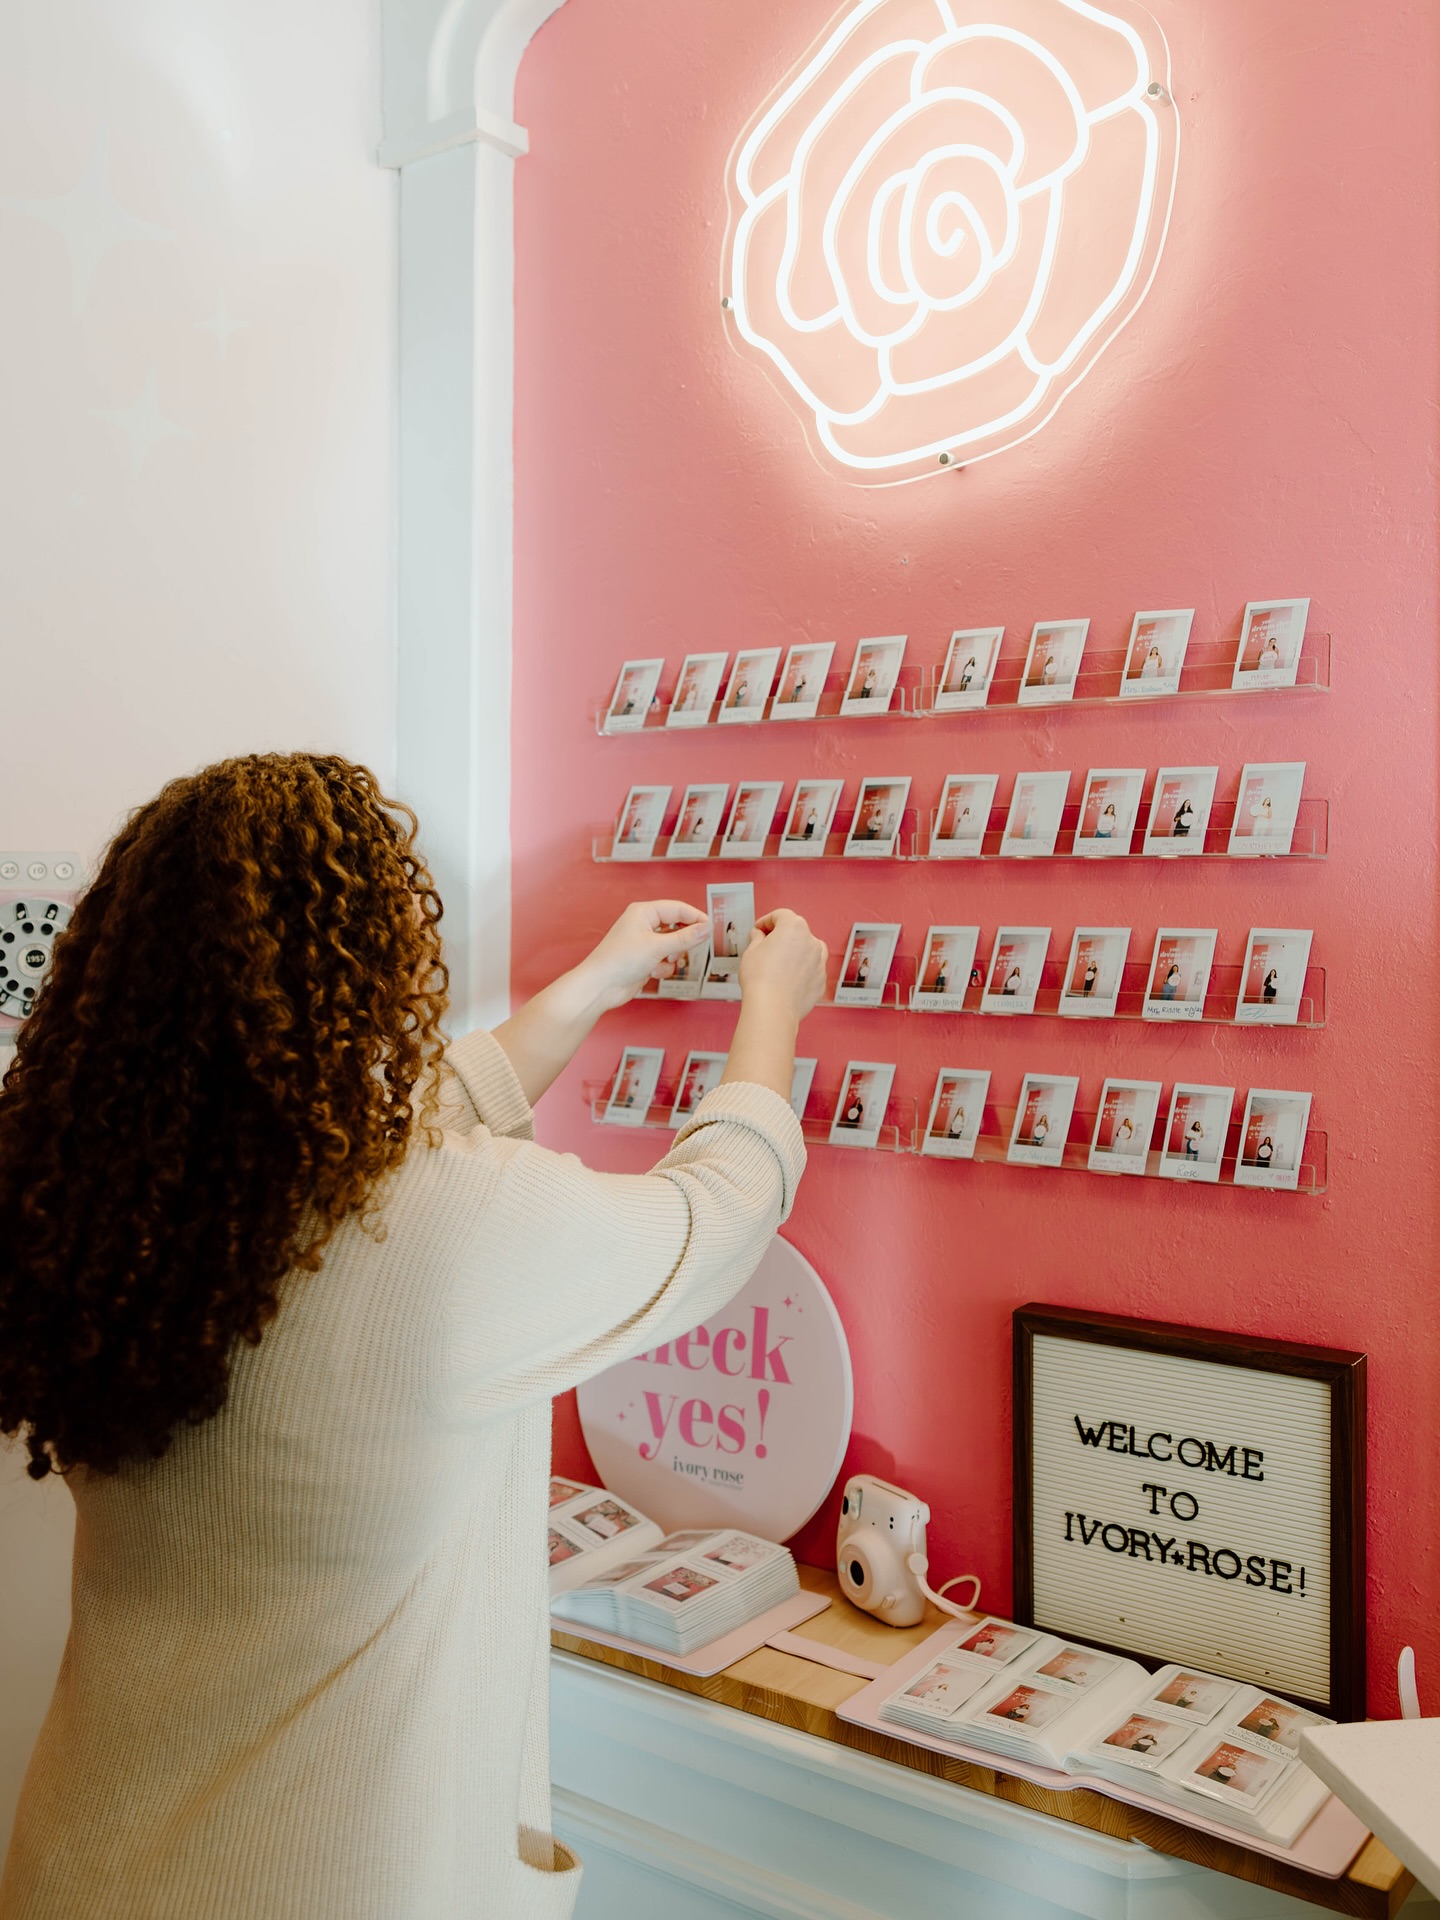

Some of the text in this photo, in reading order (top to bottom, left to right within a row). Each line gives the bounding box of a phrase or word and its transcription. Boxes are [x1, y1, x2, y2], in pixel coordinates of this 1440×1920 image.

[631, 1305, 795, 1385] eck
[638, 1388, 771, 1461] yes!
[1073, 1414, 1265, 1482] WELCOME
[673, 1455, 744, 1485] ivory rose
[1142, 1483, 1200, 1521] TO
